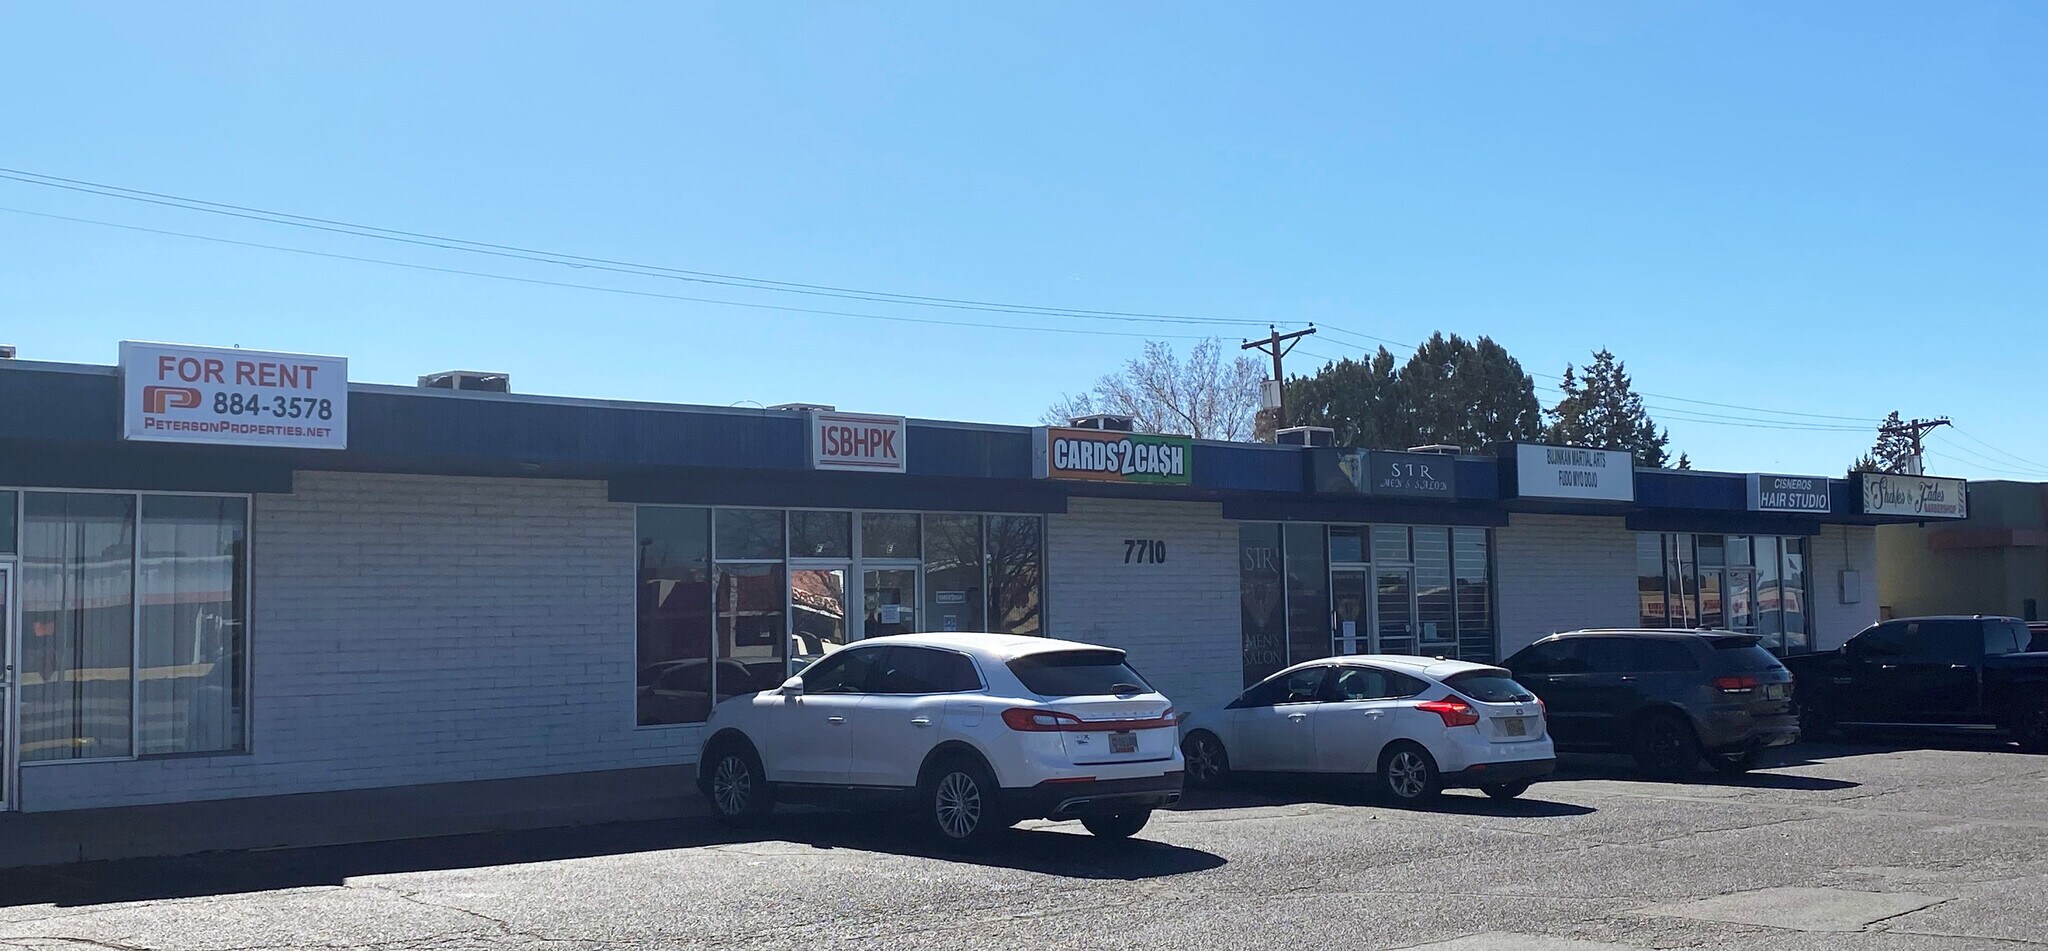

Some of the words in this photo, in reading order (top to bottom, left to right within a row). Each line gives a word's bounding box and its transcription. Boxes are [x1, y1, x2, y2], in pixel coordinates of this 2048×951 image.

[158, 355, 225, 384] FOR
[235, 360, 318, 389] RENT
[213, 391, 333, 420] 884-3578
[821, 425, 897, 458] ISBHPK
[1572, 450, 1592, 467] MARTIAL
[1593, 451, 1606, 468] ARTS
[1391, 462, 1435, 480] STR
[1584, 471, 1598, 488] DOJO
[1380, 478, 1410, 489] MENS
[1774, 478, 1812, 490] CISNEROS
[1761, 492, 1787, 507] HAIR
[1788, 493, 1827, 508] STUDIO
[1914, 481, 1945, 513] Fades
[886, 544, 894, 553] E
[1124, 539, 1166, 564] 7710
[1246, 547, 1278, 573] STR
[1243, 650, 1282, 667] SALON
